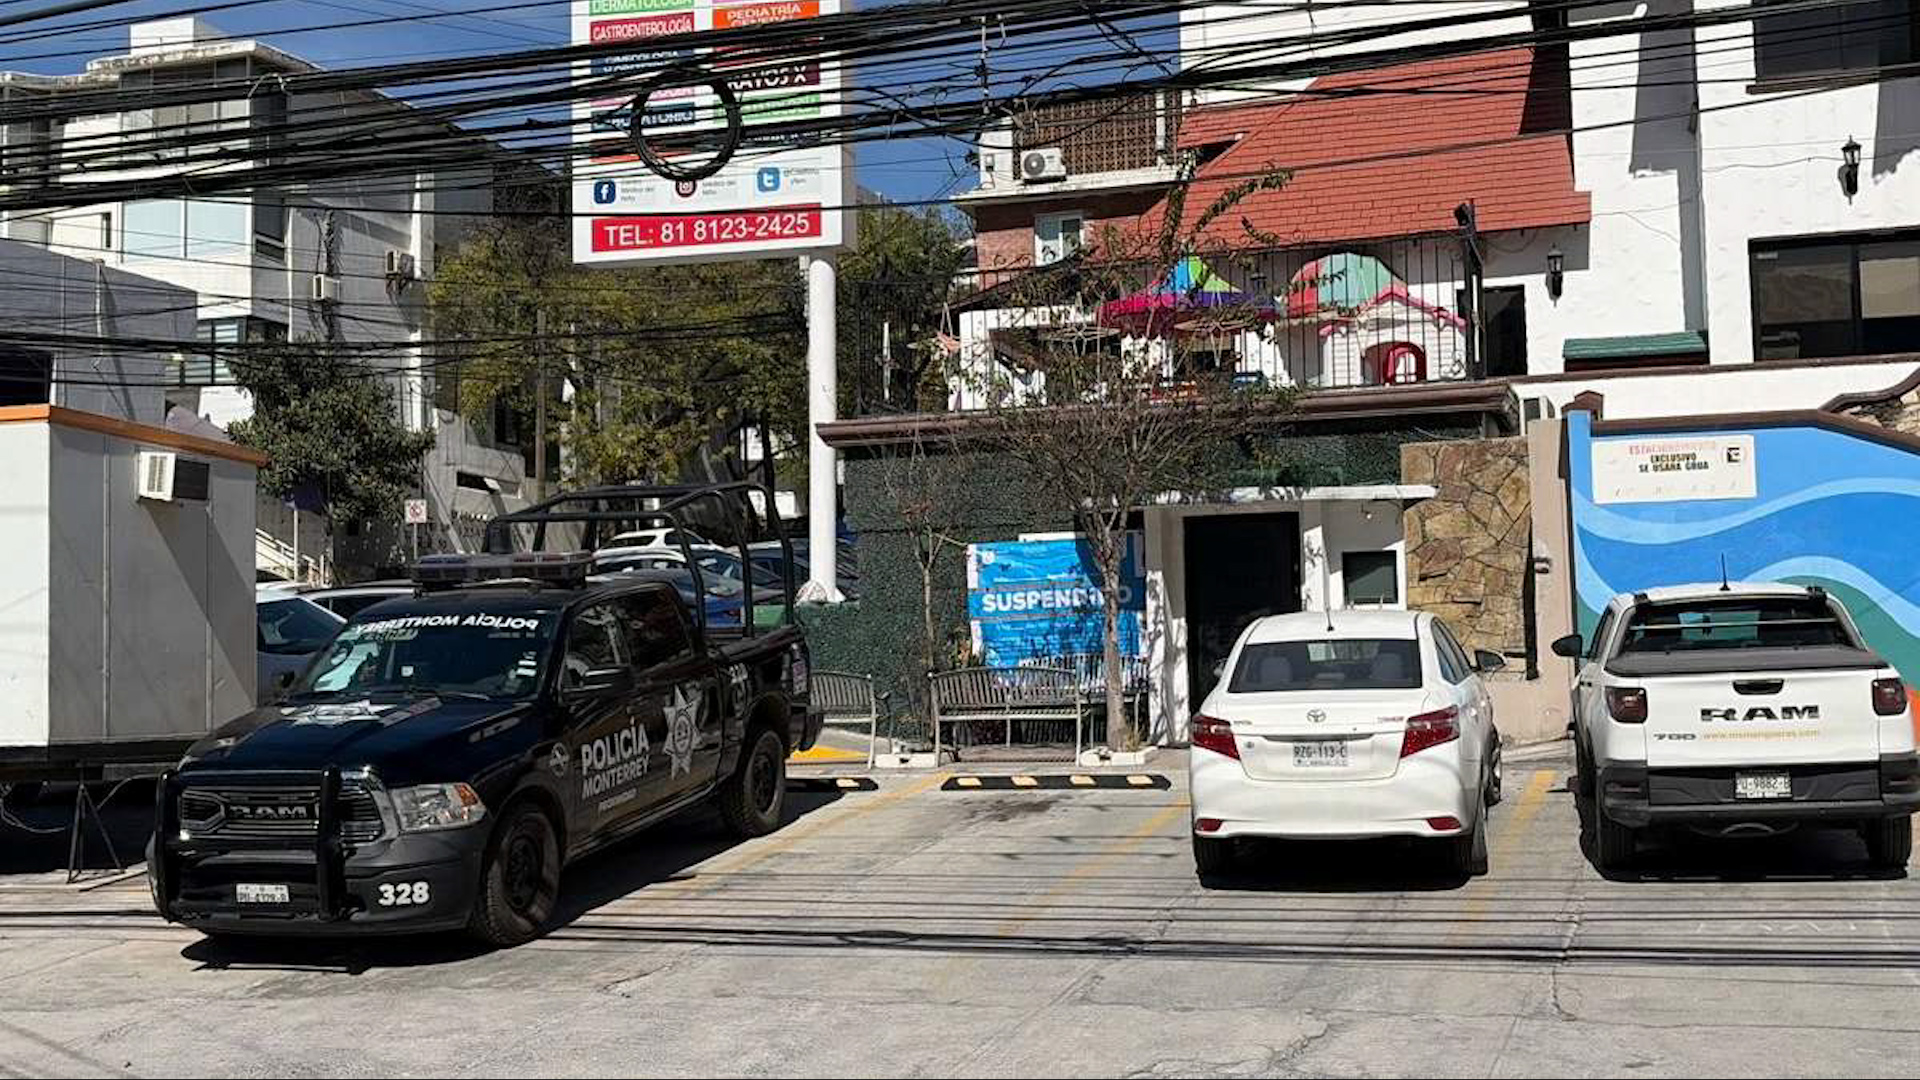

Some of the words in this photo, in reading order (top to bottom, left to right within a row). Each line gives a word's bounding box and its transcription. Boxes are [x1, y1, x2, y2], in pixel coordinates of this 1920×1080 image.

[592, 0, 692, 12] DERMATOLO
[592, 15, 692, 40] GASTROENTEROLOGÍA
[794, 65, 807, 83] X
[604, 225, 654, 246] TEL:
[660, 222, 685, 243] 81
[693, 213, 810, 240] 8123-2425
[1650, 453, 1697, 463] EXCLUSIVO
[1639, 464, 1649, 473] SE
[981, 585, 1133, 612] SUSPENDIO
[1701, 705, 1820, 721] RAM
[1653, 732, 1696, 741] 700
[581, 716, 650, 775] POLICÍA
[582, 754, 650, 799] MONTERREY
[1738, 777, 1791, 790] U-9882-B
[230, 806, 306, 819] RAM
[378, 881, 430, 906] 328
